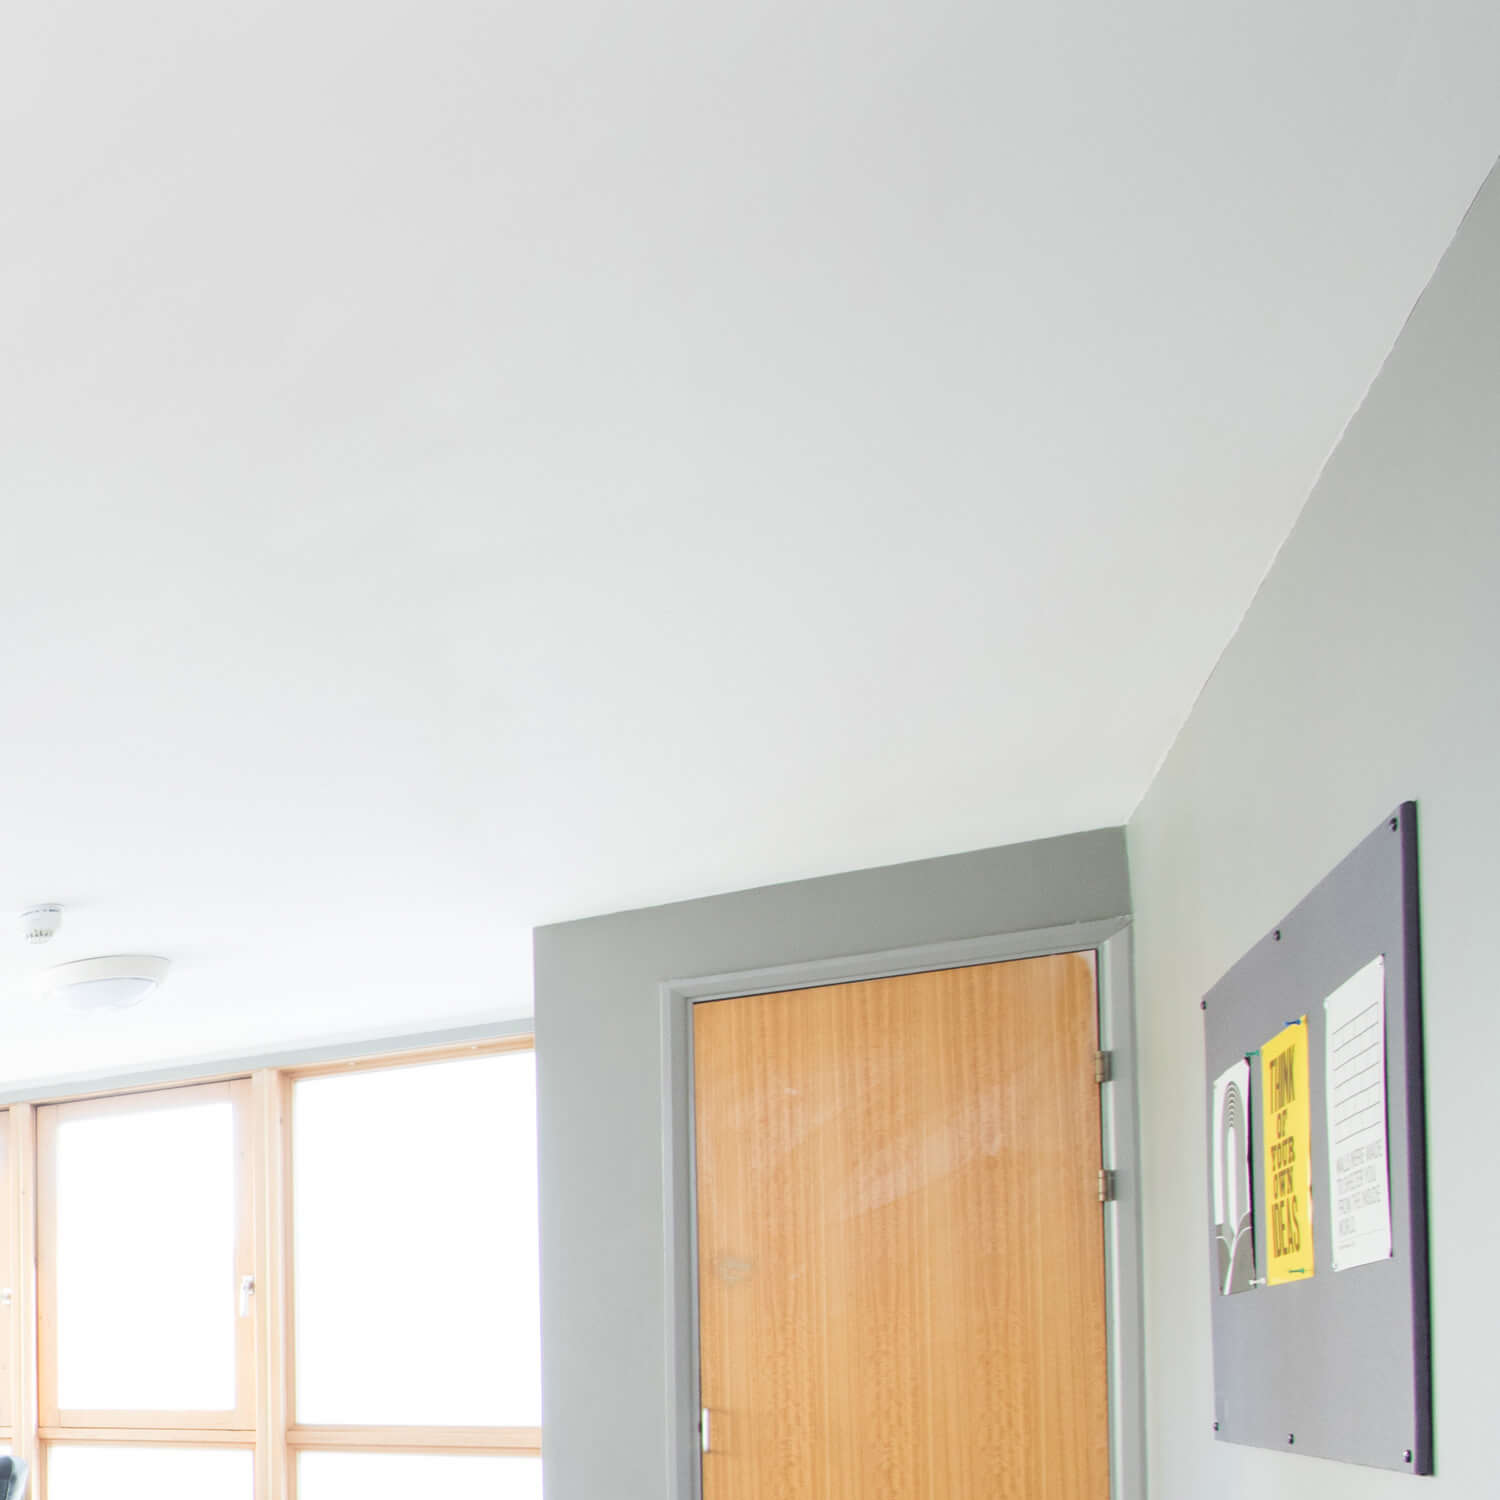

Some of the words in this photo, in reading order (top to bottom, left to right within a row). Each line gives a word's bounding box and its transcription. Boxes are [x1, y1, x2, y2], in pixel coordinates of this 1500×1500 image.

[1269, 1044, 1296, 1114] THINK
[1276, 1109, 1288, 1139] OF
[1270, 1136, 1296, 1172] YOUR
[1274, 1166, 1294, 1200] OWN
[1271, 1195, 1301, 1258] IDEAS
